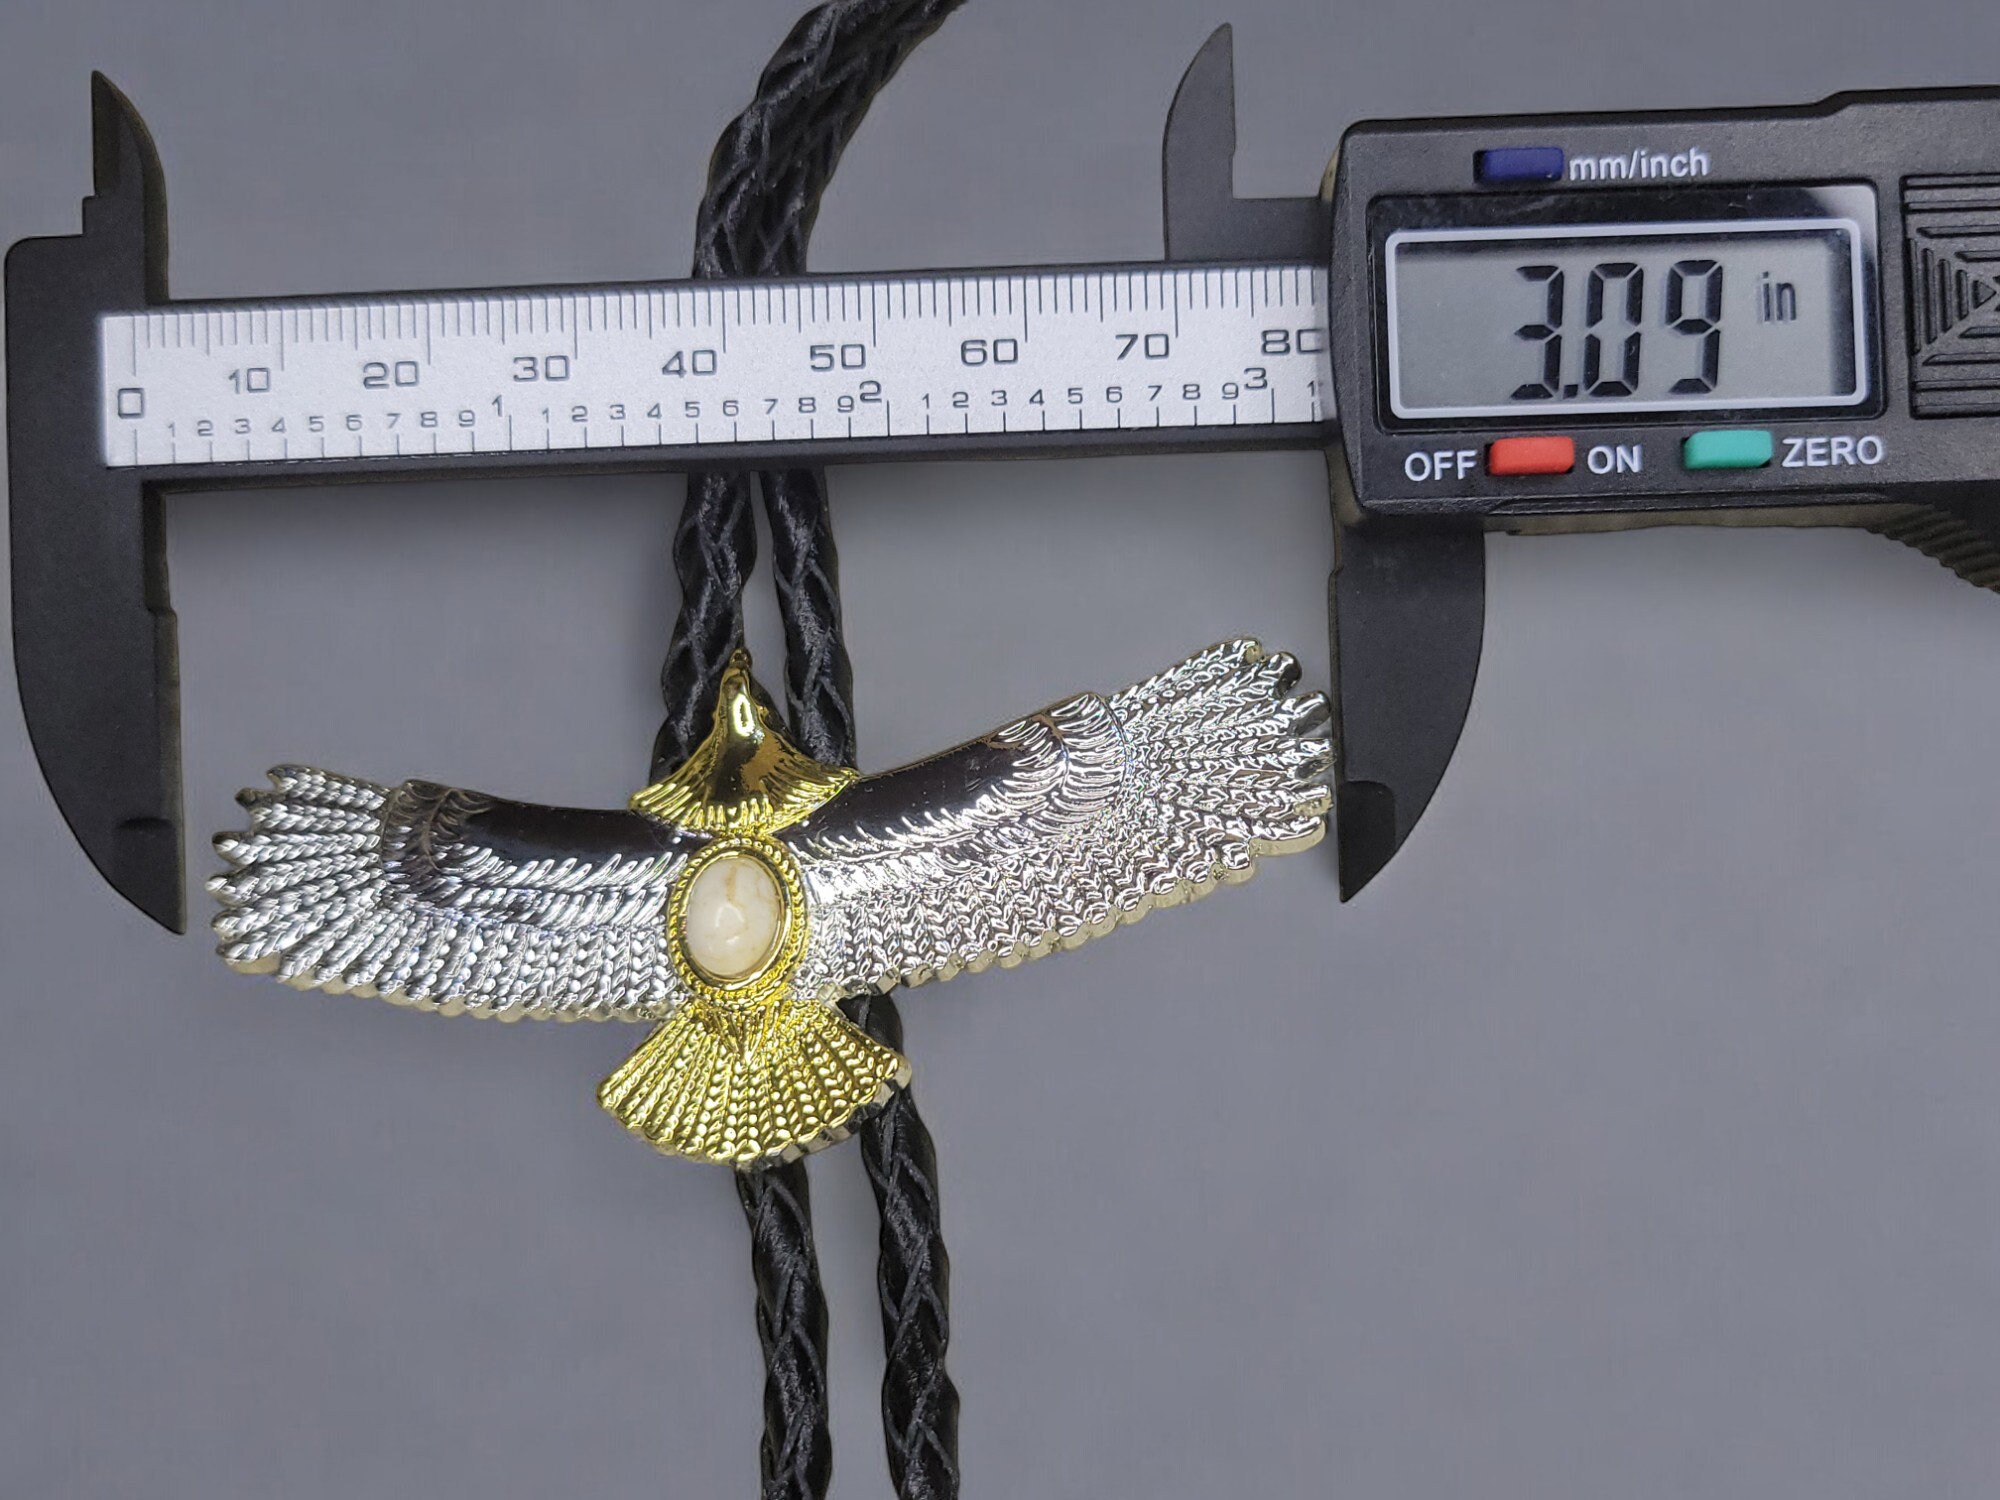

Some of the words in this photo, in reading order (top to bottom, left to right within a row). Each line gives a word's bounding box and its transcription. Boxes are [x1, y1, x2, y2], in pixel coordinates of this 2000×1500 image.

[1569, 147, 1709, 181] mm/inch
[1511, 261, 1723, 399] 3.09
[1760, 273, 1797, 323] in
[116, 387, 144, 420] 0
[228, 367, 270, 394] 10
[362, 360, 419, 390] 20
[512, 354, 569, 382] 30
[661, 349, 717, 378] 40
[809, 343, 866, 372] 50
[960, 338, 1019, 367] 60
[1115, 333, 1170, 360] 70
[167, 422, 176, 438] 1
[196, 419, 213, 437] 2
[234, 418, 251, 435] 3
[270, 417, 286, 434] 4
[308, 415, 324, 433] 5
[345, 414, 362, 432] 6
[386, 412, 401, 429] 7
[419, 410, 438, 428] 8
[458, 409, 476, 428] 9
[491, 394, 502, 417] 1
[541, 407, 550, 424] 1
[571, 405, 588, 423] 2
[609, 403, 626, 420] 3
[646, 402, 662, 420] 4
[684, 401, 700, 419] 5
[722, 399, 739, 417] 6
[764, 398, 779, 415] 7
[798, 396, 817, 414] 8
[837, 395, 855, 413] 9
[859, 379, 882, 403] 2
[922, 393, 930, 409] 1
[952, 391, 969, 409] 2
[991, 389, 1008, 407] 3
[1029, 388, 1045, 406] 4
[1067, 387, 1084, 405] 5
[1105, 386, 1123, 404] 6
[1147, 384, 1163, 401] 7
[1182, 383, 1201, 401] 8
[1221, 382, 1239, 400] 9
[1243, 367, 1268, 390] 3
[1307, 380, 1316, 397] 1
[1404, 450, 1477, 482] OFF
[1587, 445, 1642, 475] ON
[1782, 435, 1885, 468] ZERO
